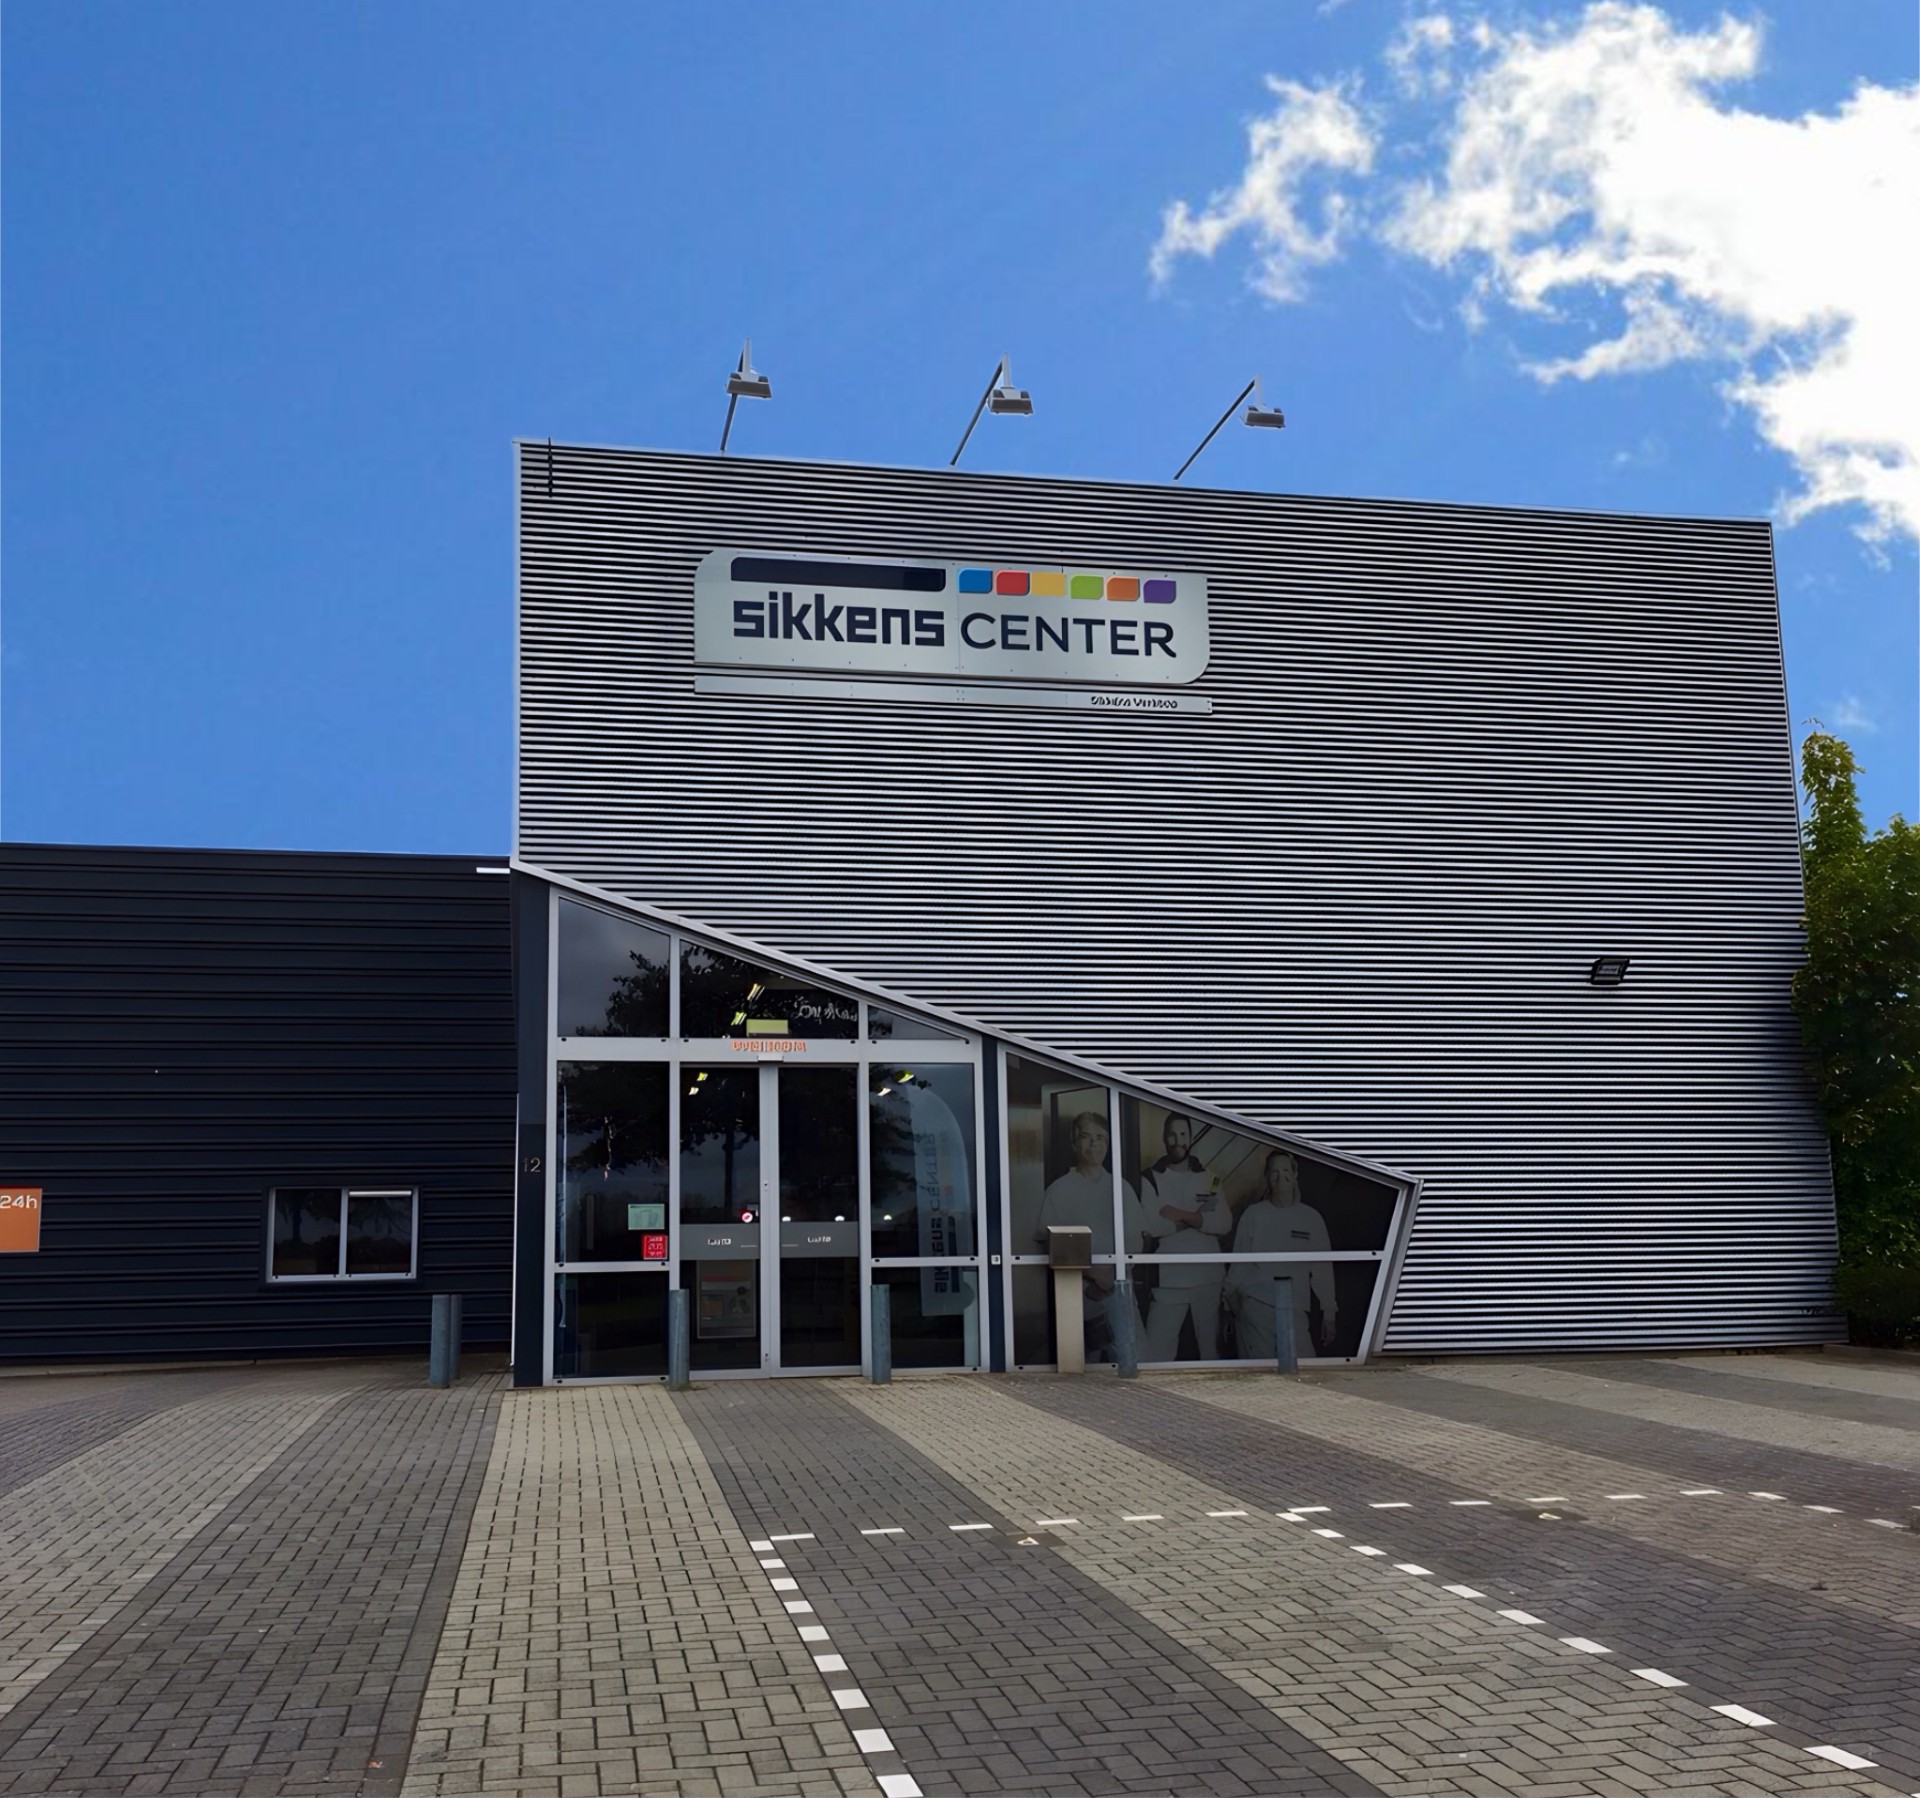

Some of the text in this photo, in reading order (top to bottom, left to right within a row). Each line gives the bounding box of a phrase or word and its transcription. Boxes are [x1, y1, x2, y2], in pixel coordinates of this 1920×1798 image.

[733, 591, 1177, 658] sikkens CENTER
[524, 1157, 541, 1172] 12
[0, 1195, 38, 1209] 24h
